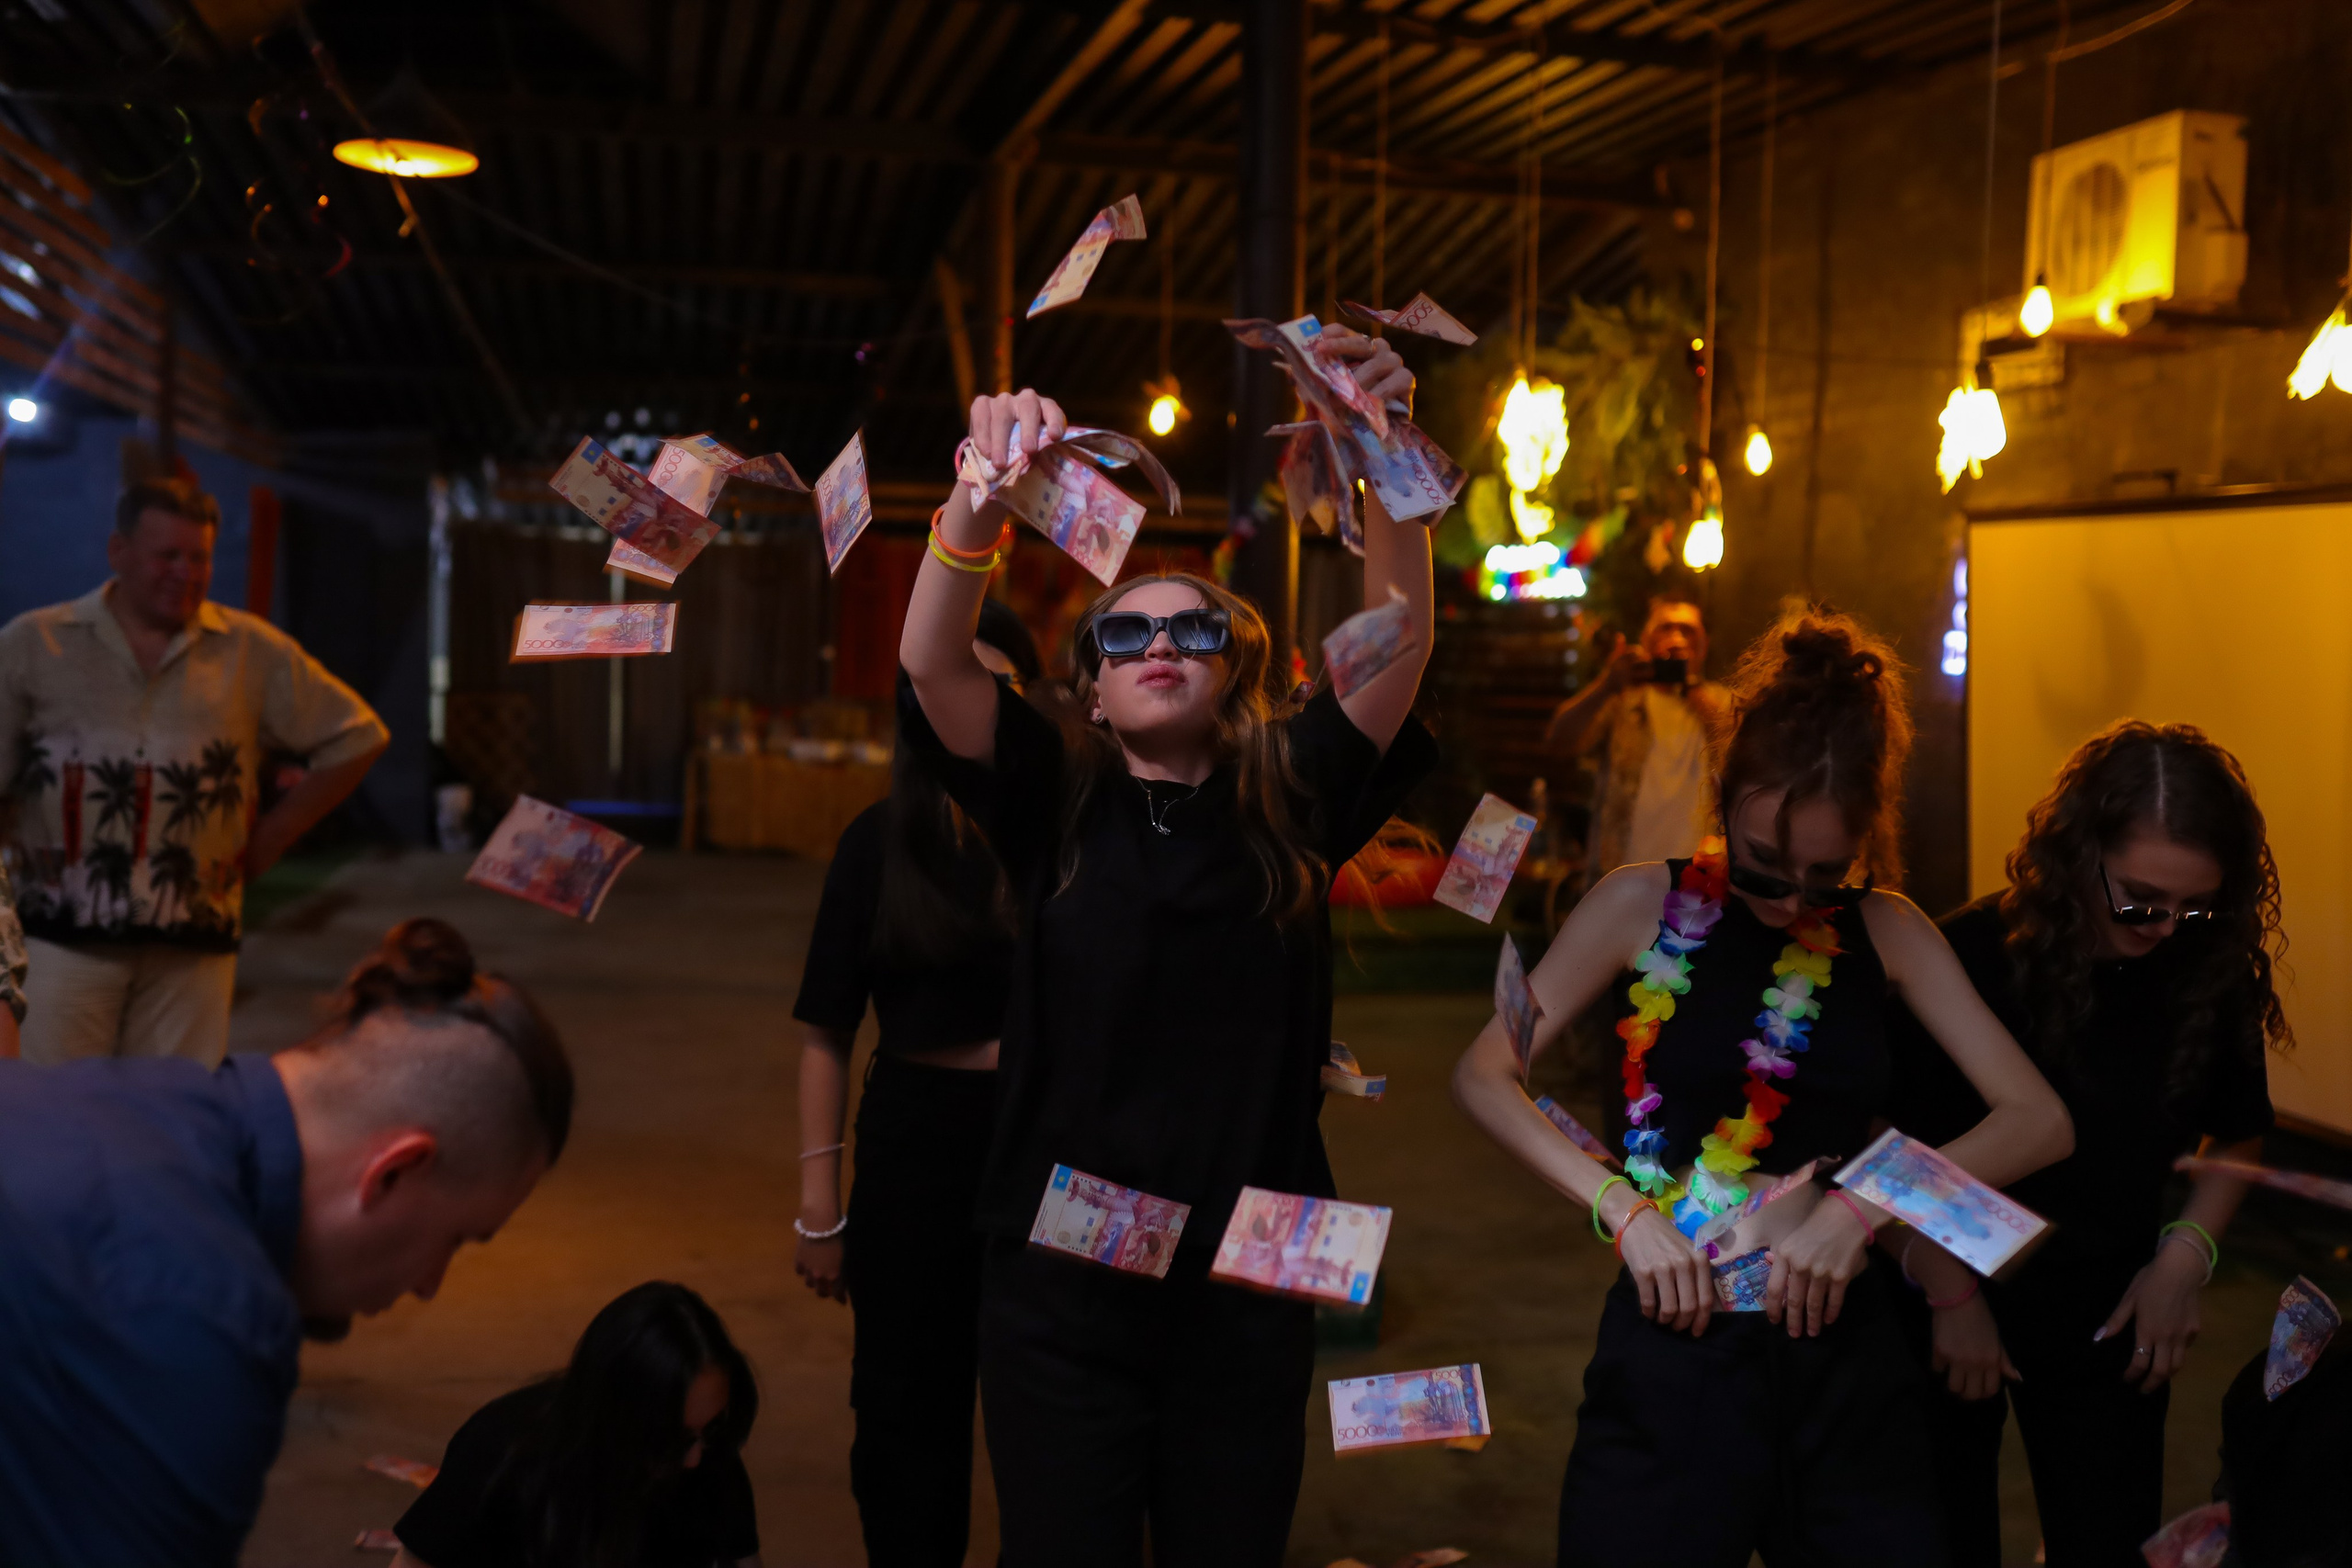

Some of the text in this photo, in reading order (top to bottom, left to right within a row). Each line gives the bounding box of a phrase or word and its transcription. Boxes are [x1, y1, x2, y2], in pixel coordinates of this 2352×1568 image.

[1415, 468, 1445, 505] 5000
[524, 639, 564, 649] 5000
[1986, 1201, 2032, 1235] 5000
[1338, 1425, 1378, 1441] 5000
